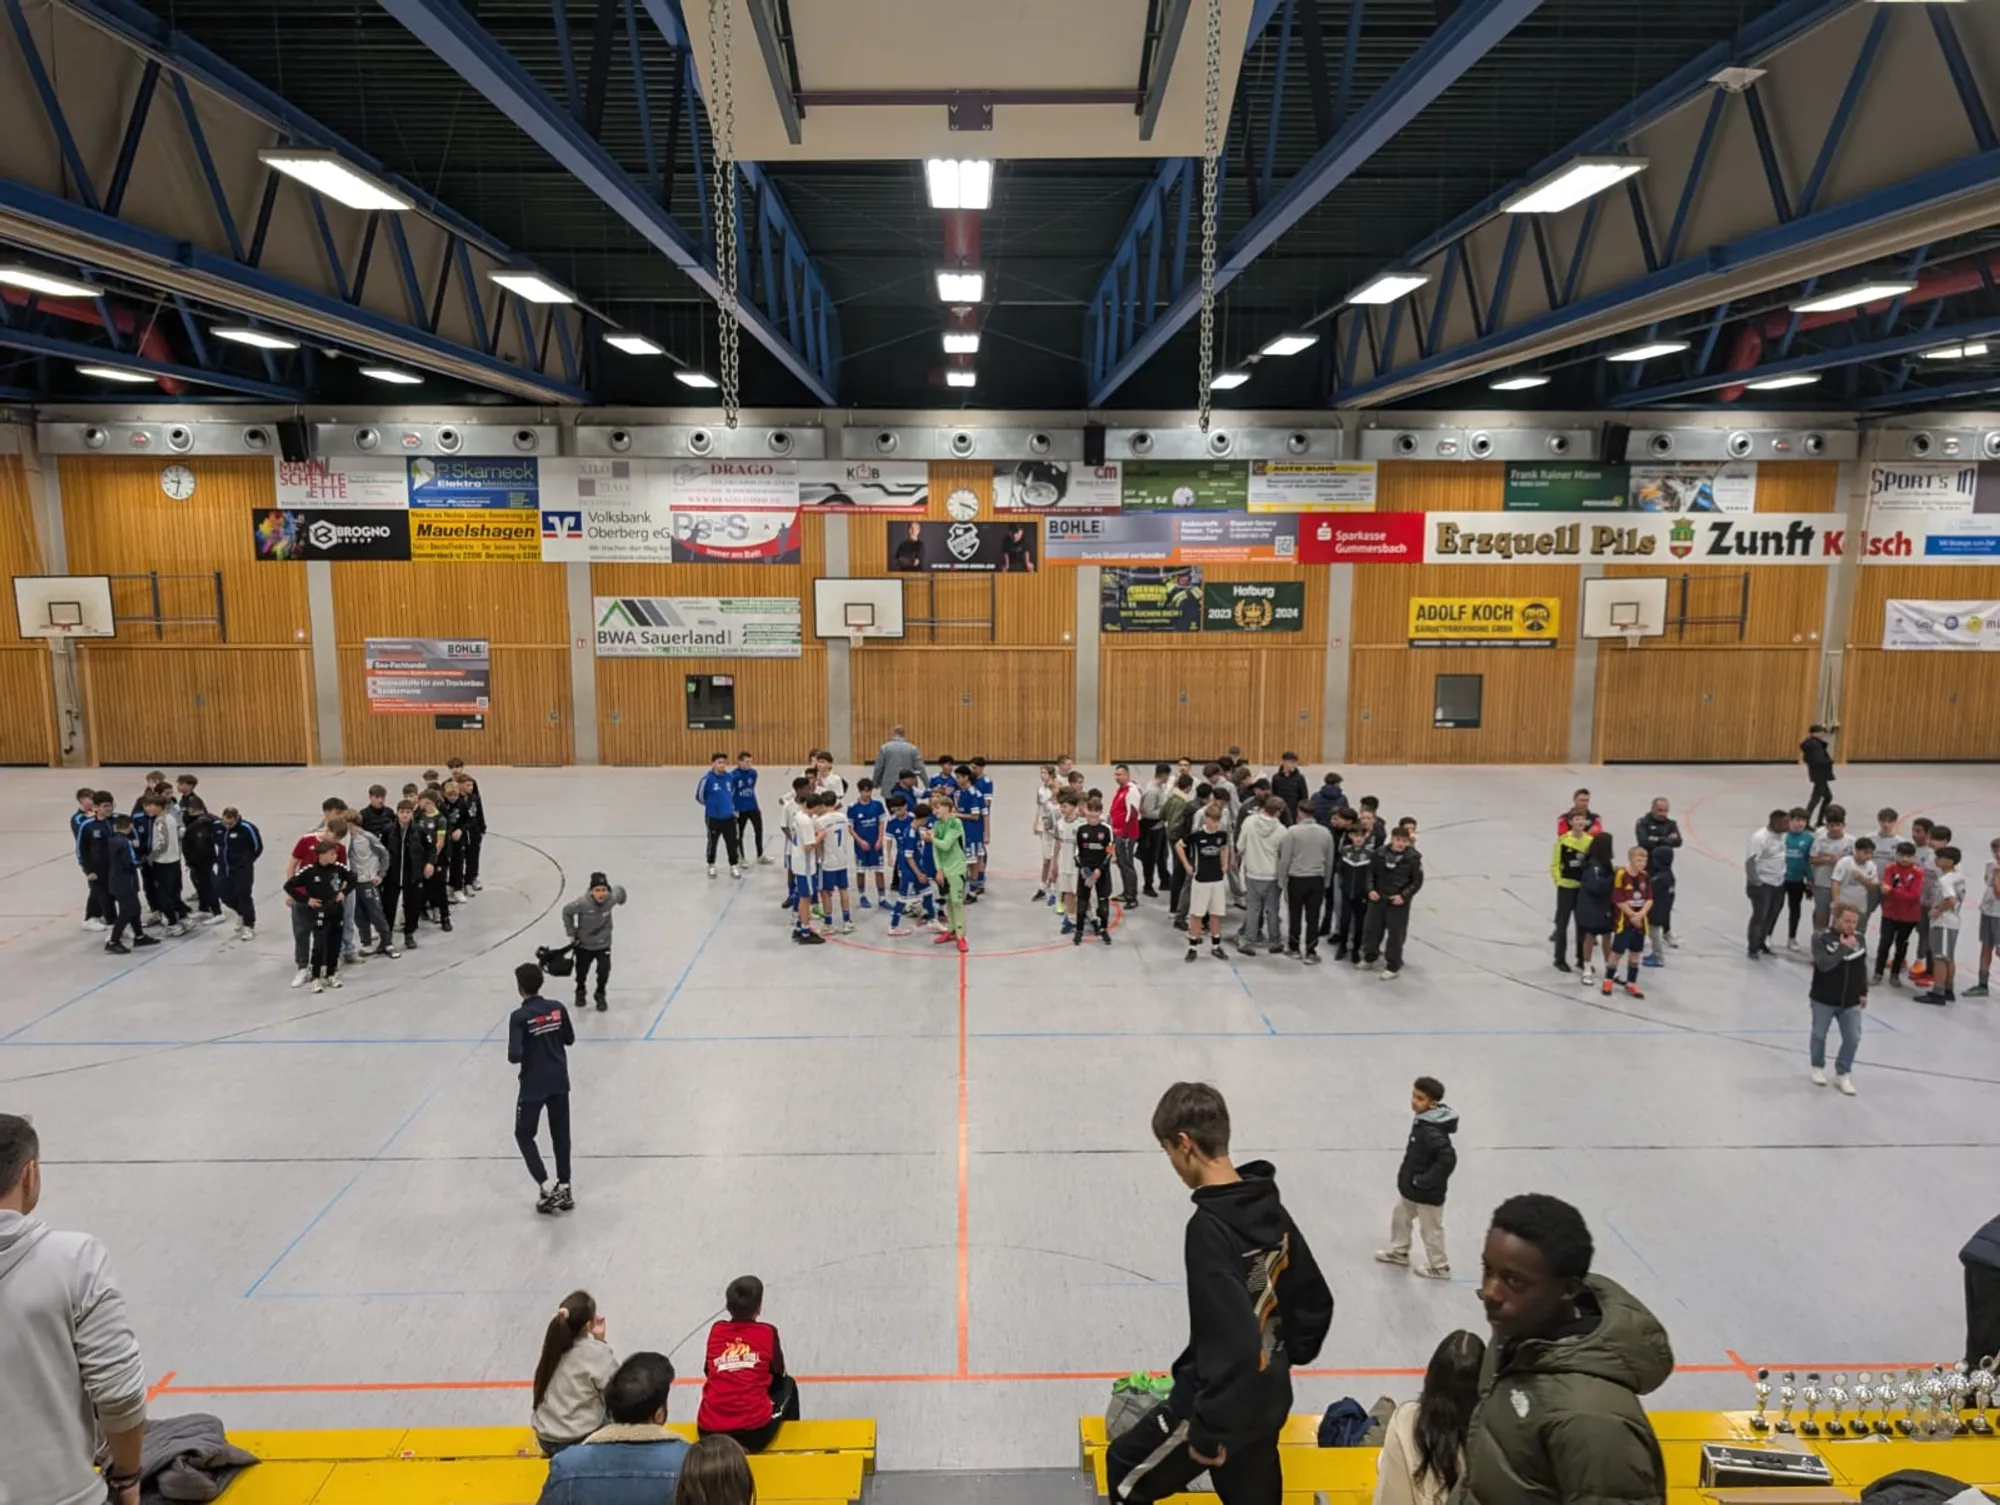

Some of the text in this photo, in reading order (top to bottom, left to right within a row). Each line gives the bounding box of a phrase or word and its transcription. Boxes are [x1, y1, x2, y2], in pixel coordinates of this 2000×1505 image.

[710, 463, 774, 476] DRAGO
[437, 480, 482, 489] Elektro
[588, 511, 652, 524] Volksbank
[337, 526, 391, 538] BROGNO
[416, 523, 536, 541] Mauelshagen
[1049, 520, 1101, 534] BOHLE
[587, 526, 671, 542] Oberberg eG
[1335, 530, 1388, 543] Sparkasse
[1436, 521, 1657, 559] Erzquell Pils
[1706, 520, 1816, 556] Zunft
[1334, 543, 1408, 555] Gummersbach
[1233, 585, 1276, 598] Hofburg
[1208, 607, 1299, 620] 2023 2024
[1416, 604, 1515, 621] ADOLF KOCH
[597, 630, 637, 645] BWA
[641, 629, 725, 645] Sauerland
[447, 644, 482, 654] BOHLE
